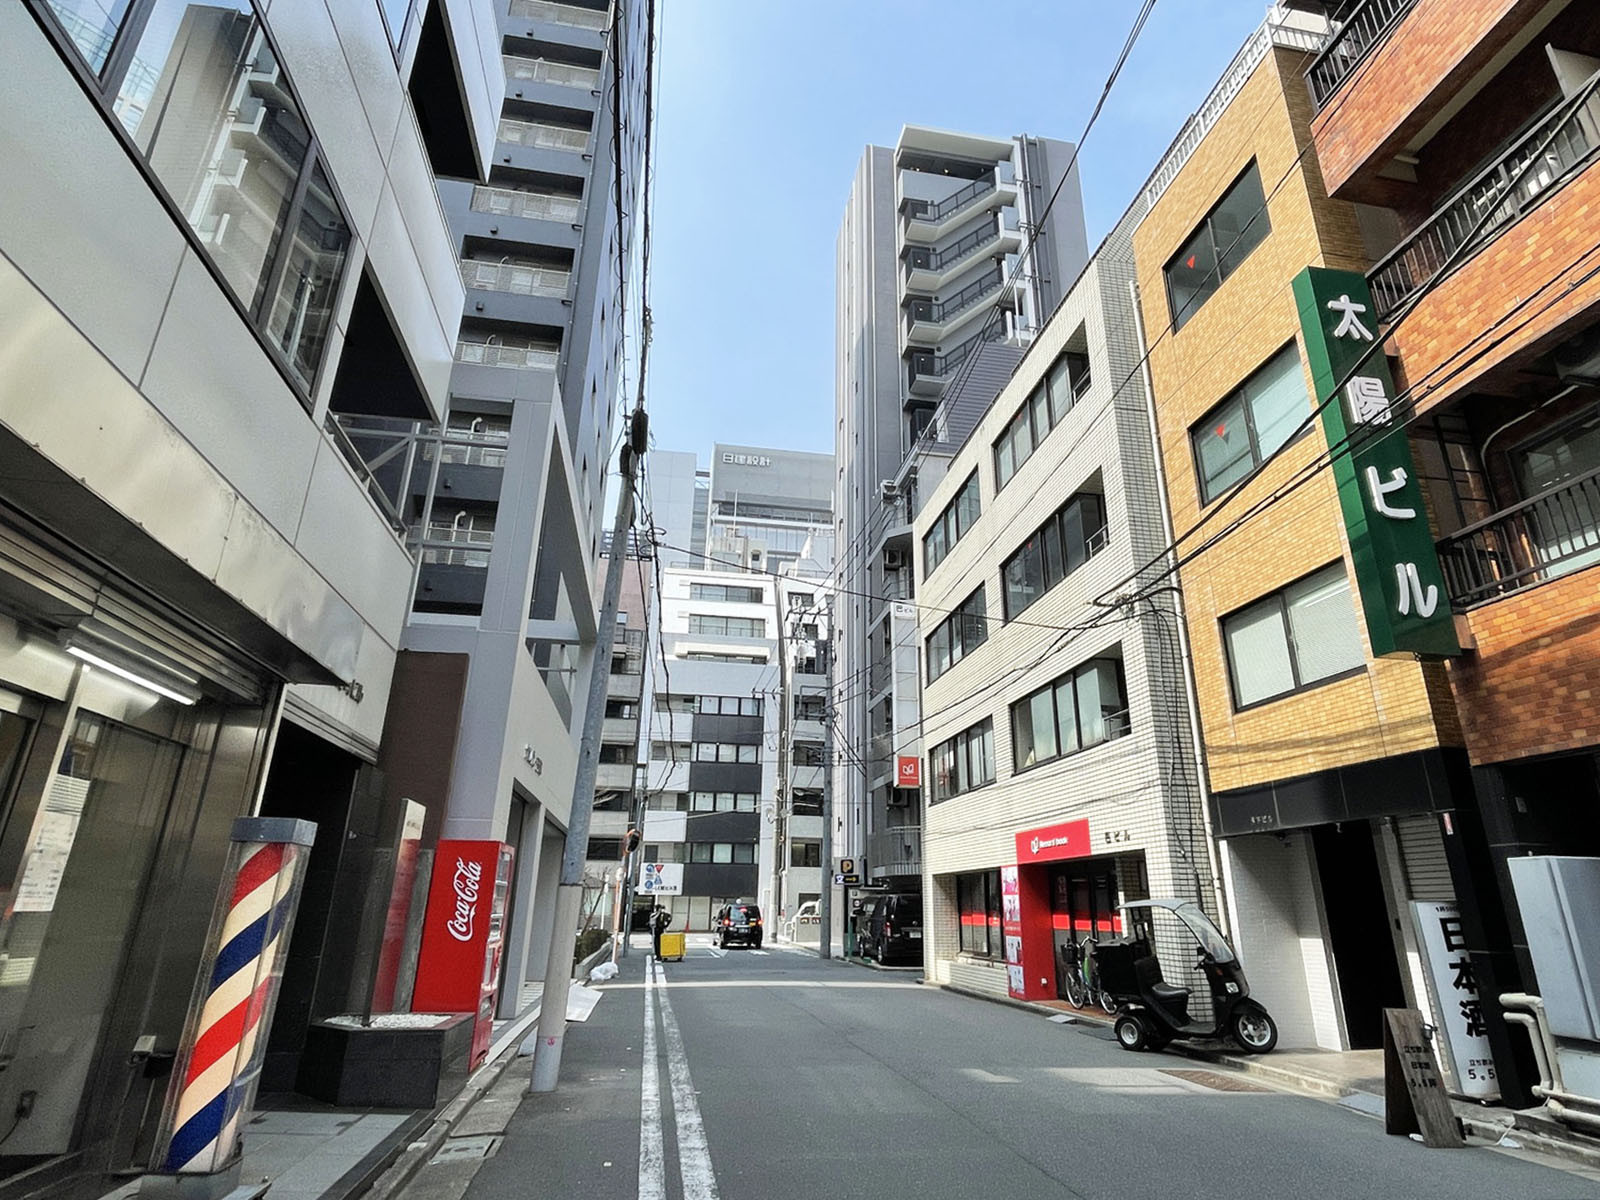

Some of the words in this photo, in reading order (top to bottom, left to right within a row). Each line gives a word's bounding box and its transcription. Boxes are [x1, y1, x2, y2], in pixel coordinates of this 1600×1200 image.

[722, 452, 771, 467] 日建設計
[1327, 293, 1439, 618] 太陽ビル
[446, 856, 482, 942] Coca-Cola
[1439, 917, 1488, 1037] 日本酒
